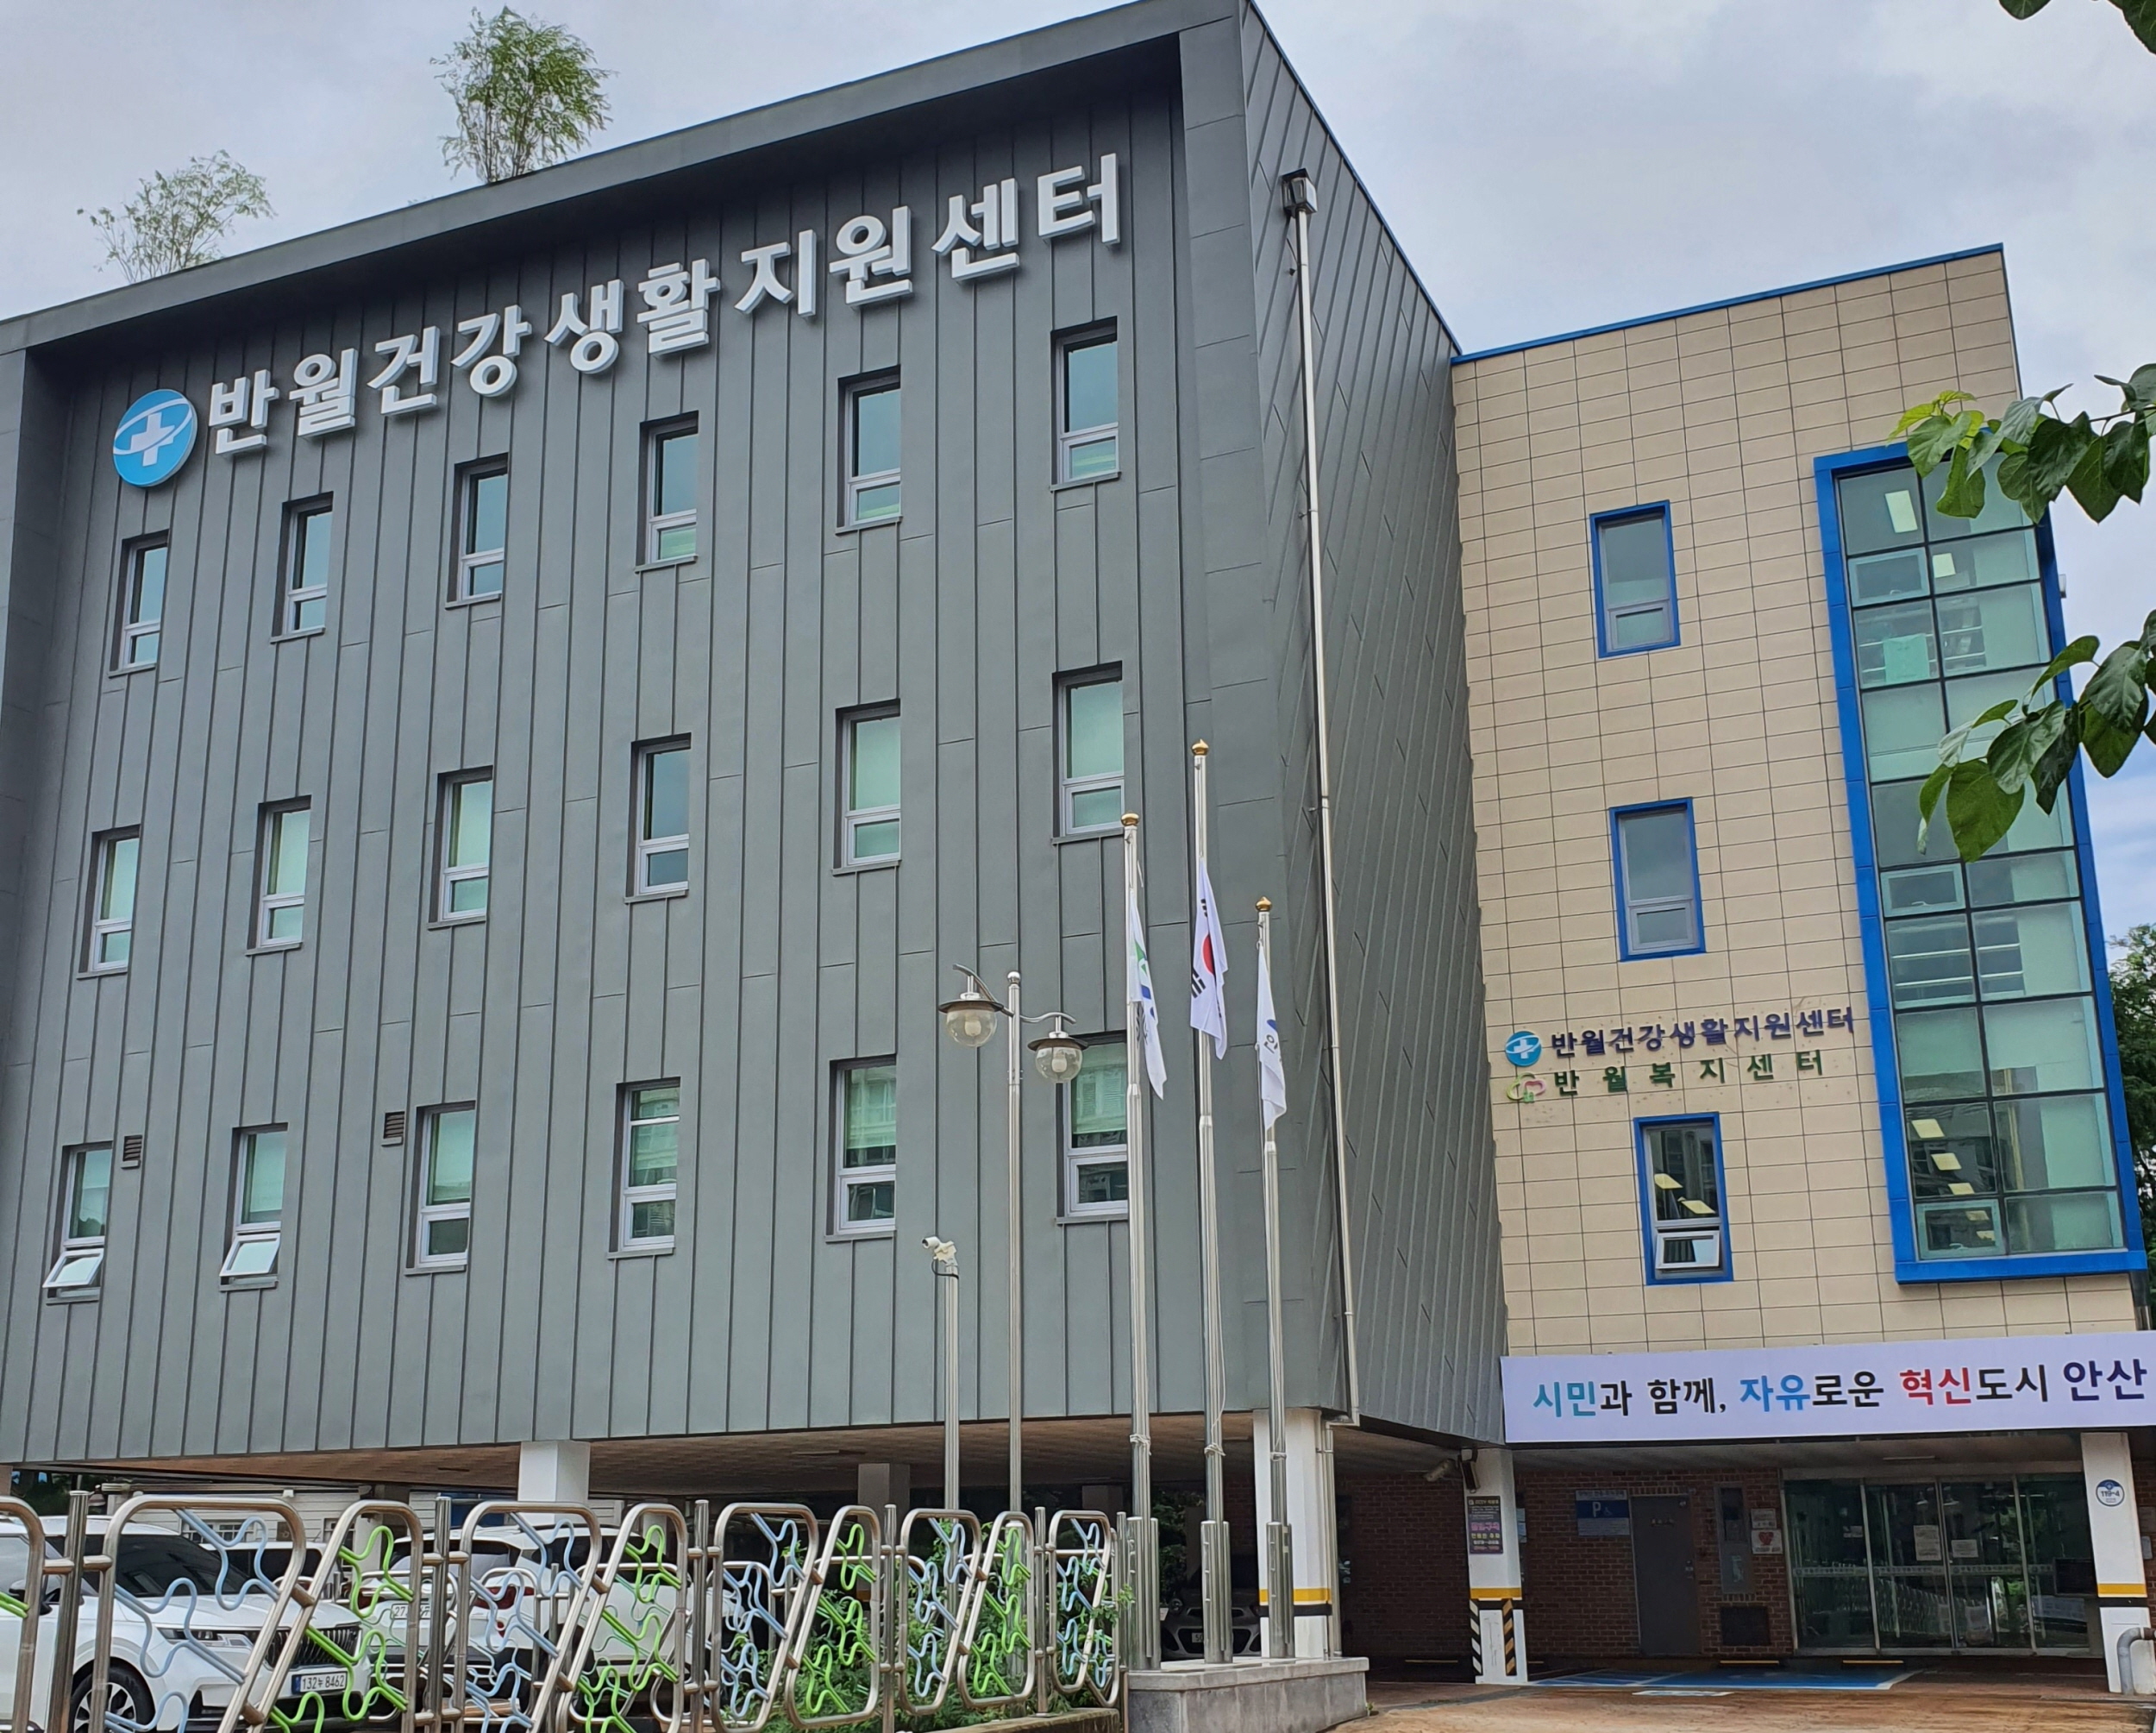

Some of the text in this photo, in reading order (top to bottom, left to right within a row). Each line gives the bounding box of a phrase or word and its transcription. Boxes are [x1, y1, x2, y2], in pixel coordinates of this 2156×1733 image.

[206, 153, 1121, 455] 반월건강생활지원센터
[1551, 1007, 1853, 1058] 반월건강생활지원센터
[1532, 1359, 2147, 1418] 시민과 함께, 자유로운 혁신도시 안산
[1592, 1501, 1601, 1517] P
